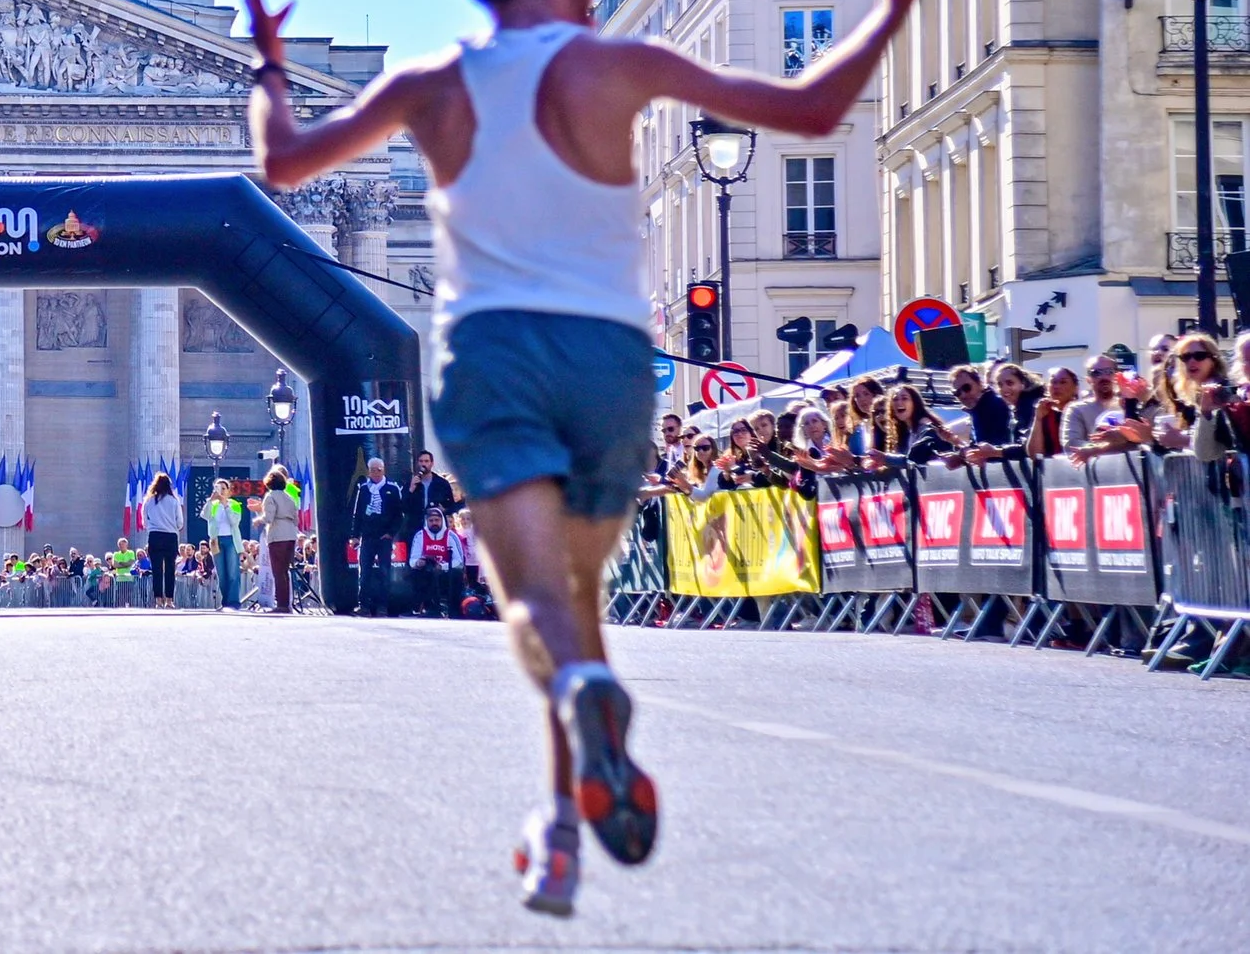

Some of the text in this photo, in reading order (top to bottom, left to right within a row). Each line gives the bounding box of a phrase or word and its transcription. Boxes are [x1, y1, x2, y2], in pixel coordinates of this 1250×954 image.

[25, 124, 233, 144] RECONNAISSANTE
[343, 415, 400, 430] TROCADERO
[927, 498, 955, 540] RMC
